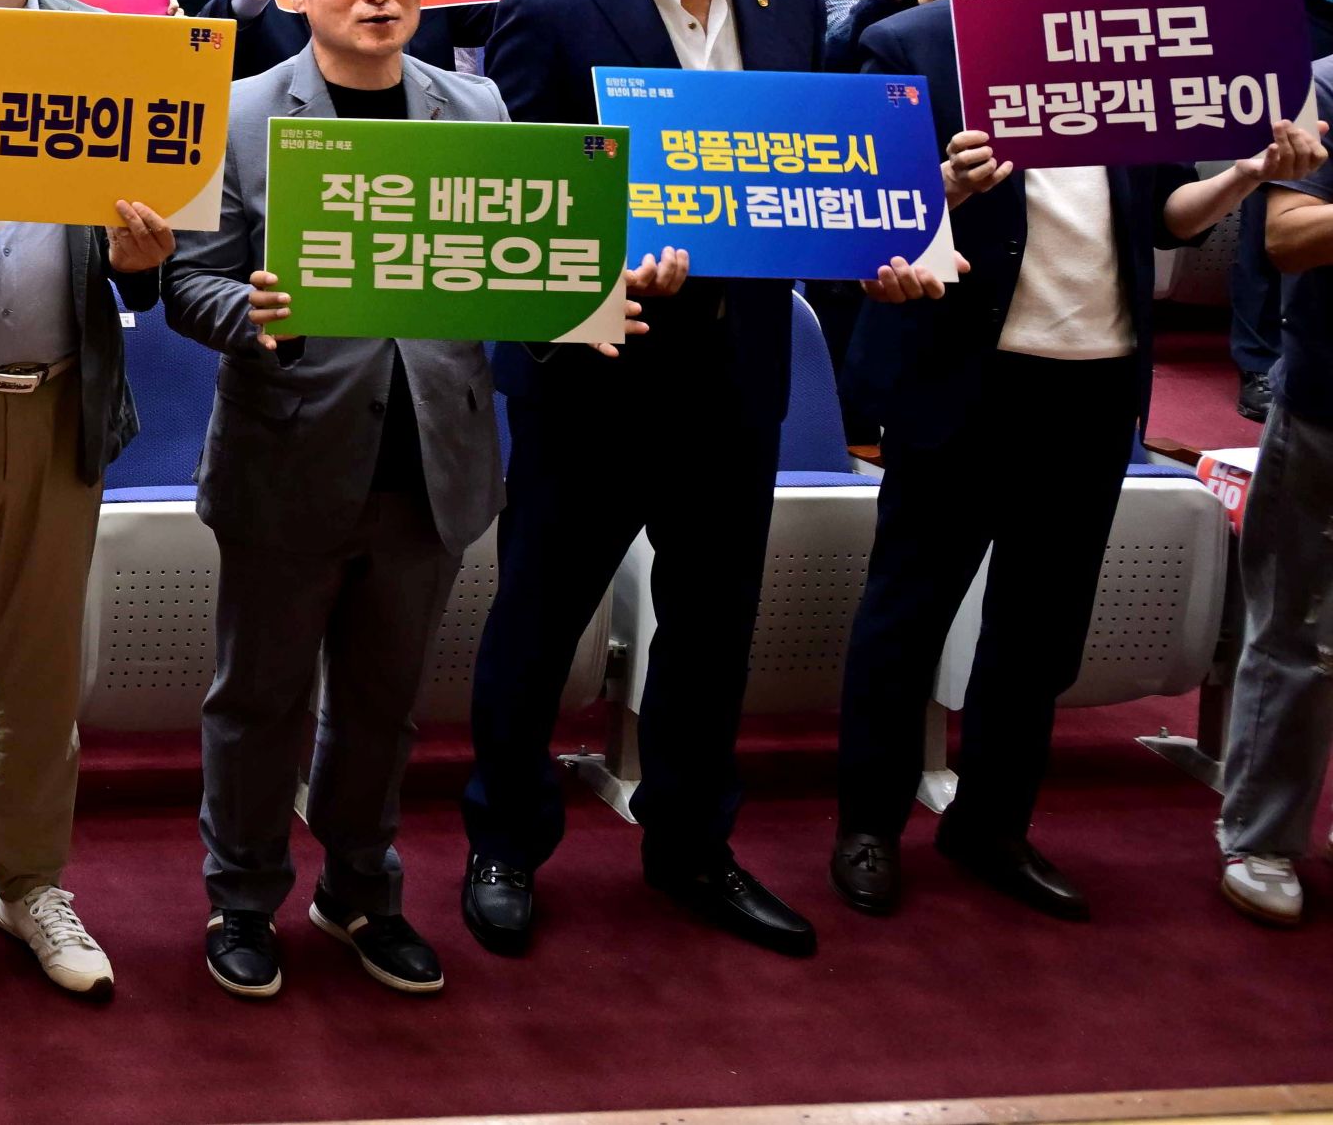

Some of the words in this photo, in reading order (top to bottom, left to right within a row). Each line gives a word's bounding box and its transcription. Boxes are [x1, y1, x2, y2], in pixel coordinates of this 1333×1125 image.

[190, 28, 223, 52] 목포랑
[1043, 6, 1214, 62] 대규모
[146, 98, 205, 165] 힘!
[988, 79, 1157, 138] 관광객
[1170, 73, 1281, 130] 맞이
[661, 129, 878, 175] 명품관광도시
[321, 174, 415, 222] 작은
[430, 177, 573, 226] 배려가
[629, 183, 738, 227] 목포가
[745, 185, 928, 231] 준비합니다
[298, 230, 355, 288] 큰
[372, 233, 601, 293] 감동으로
